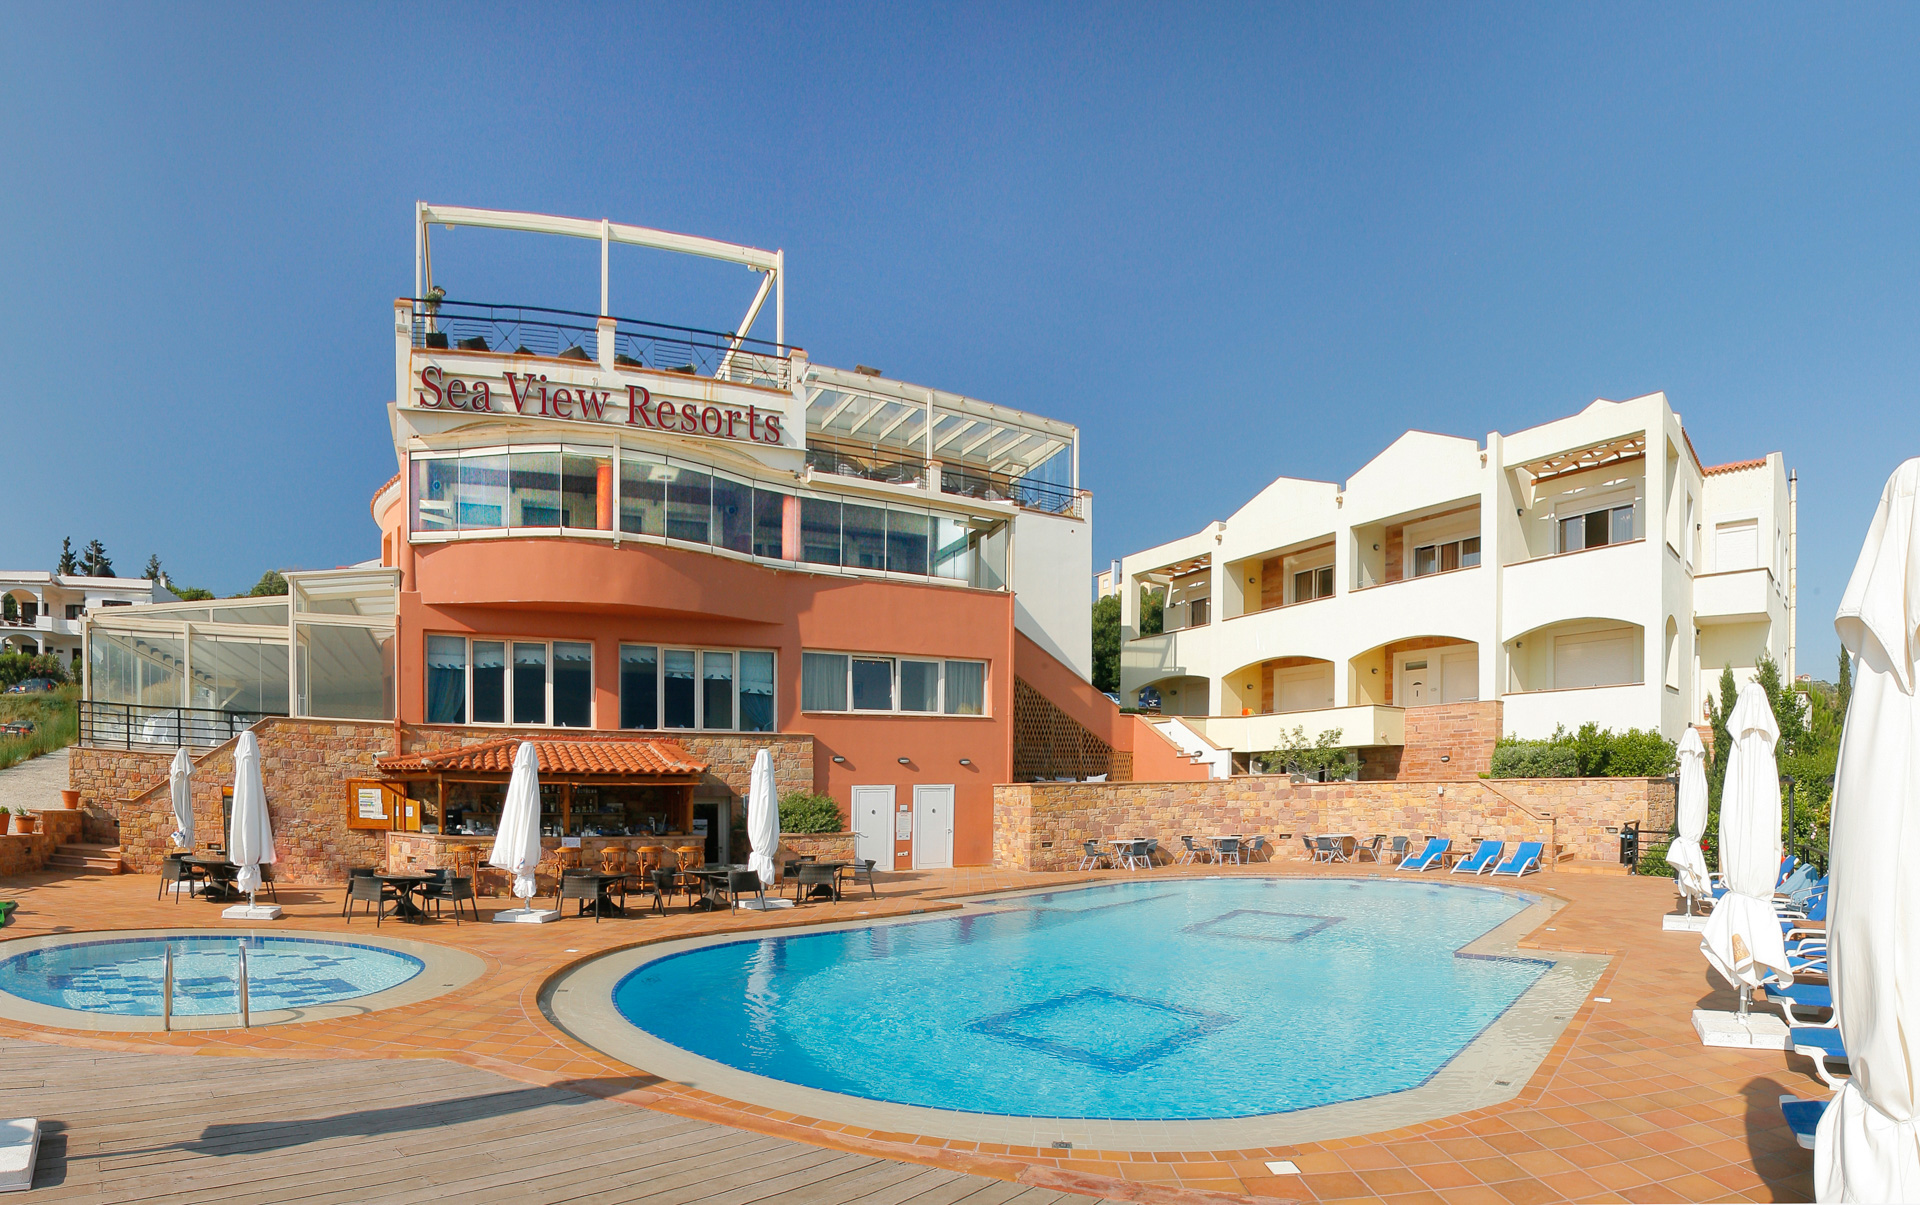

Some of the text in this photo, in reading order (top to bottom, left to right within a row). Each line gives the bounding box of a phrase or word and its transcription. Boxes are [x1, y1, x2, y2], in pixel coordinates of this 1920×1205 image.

[419, 366, 782, 443] Sea View Resorts
